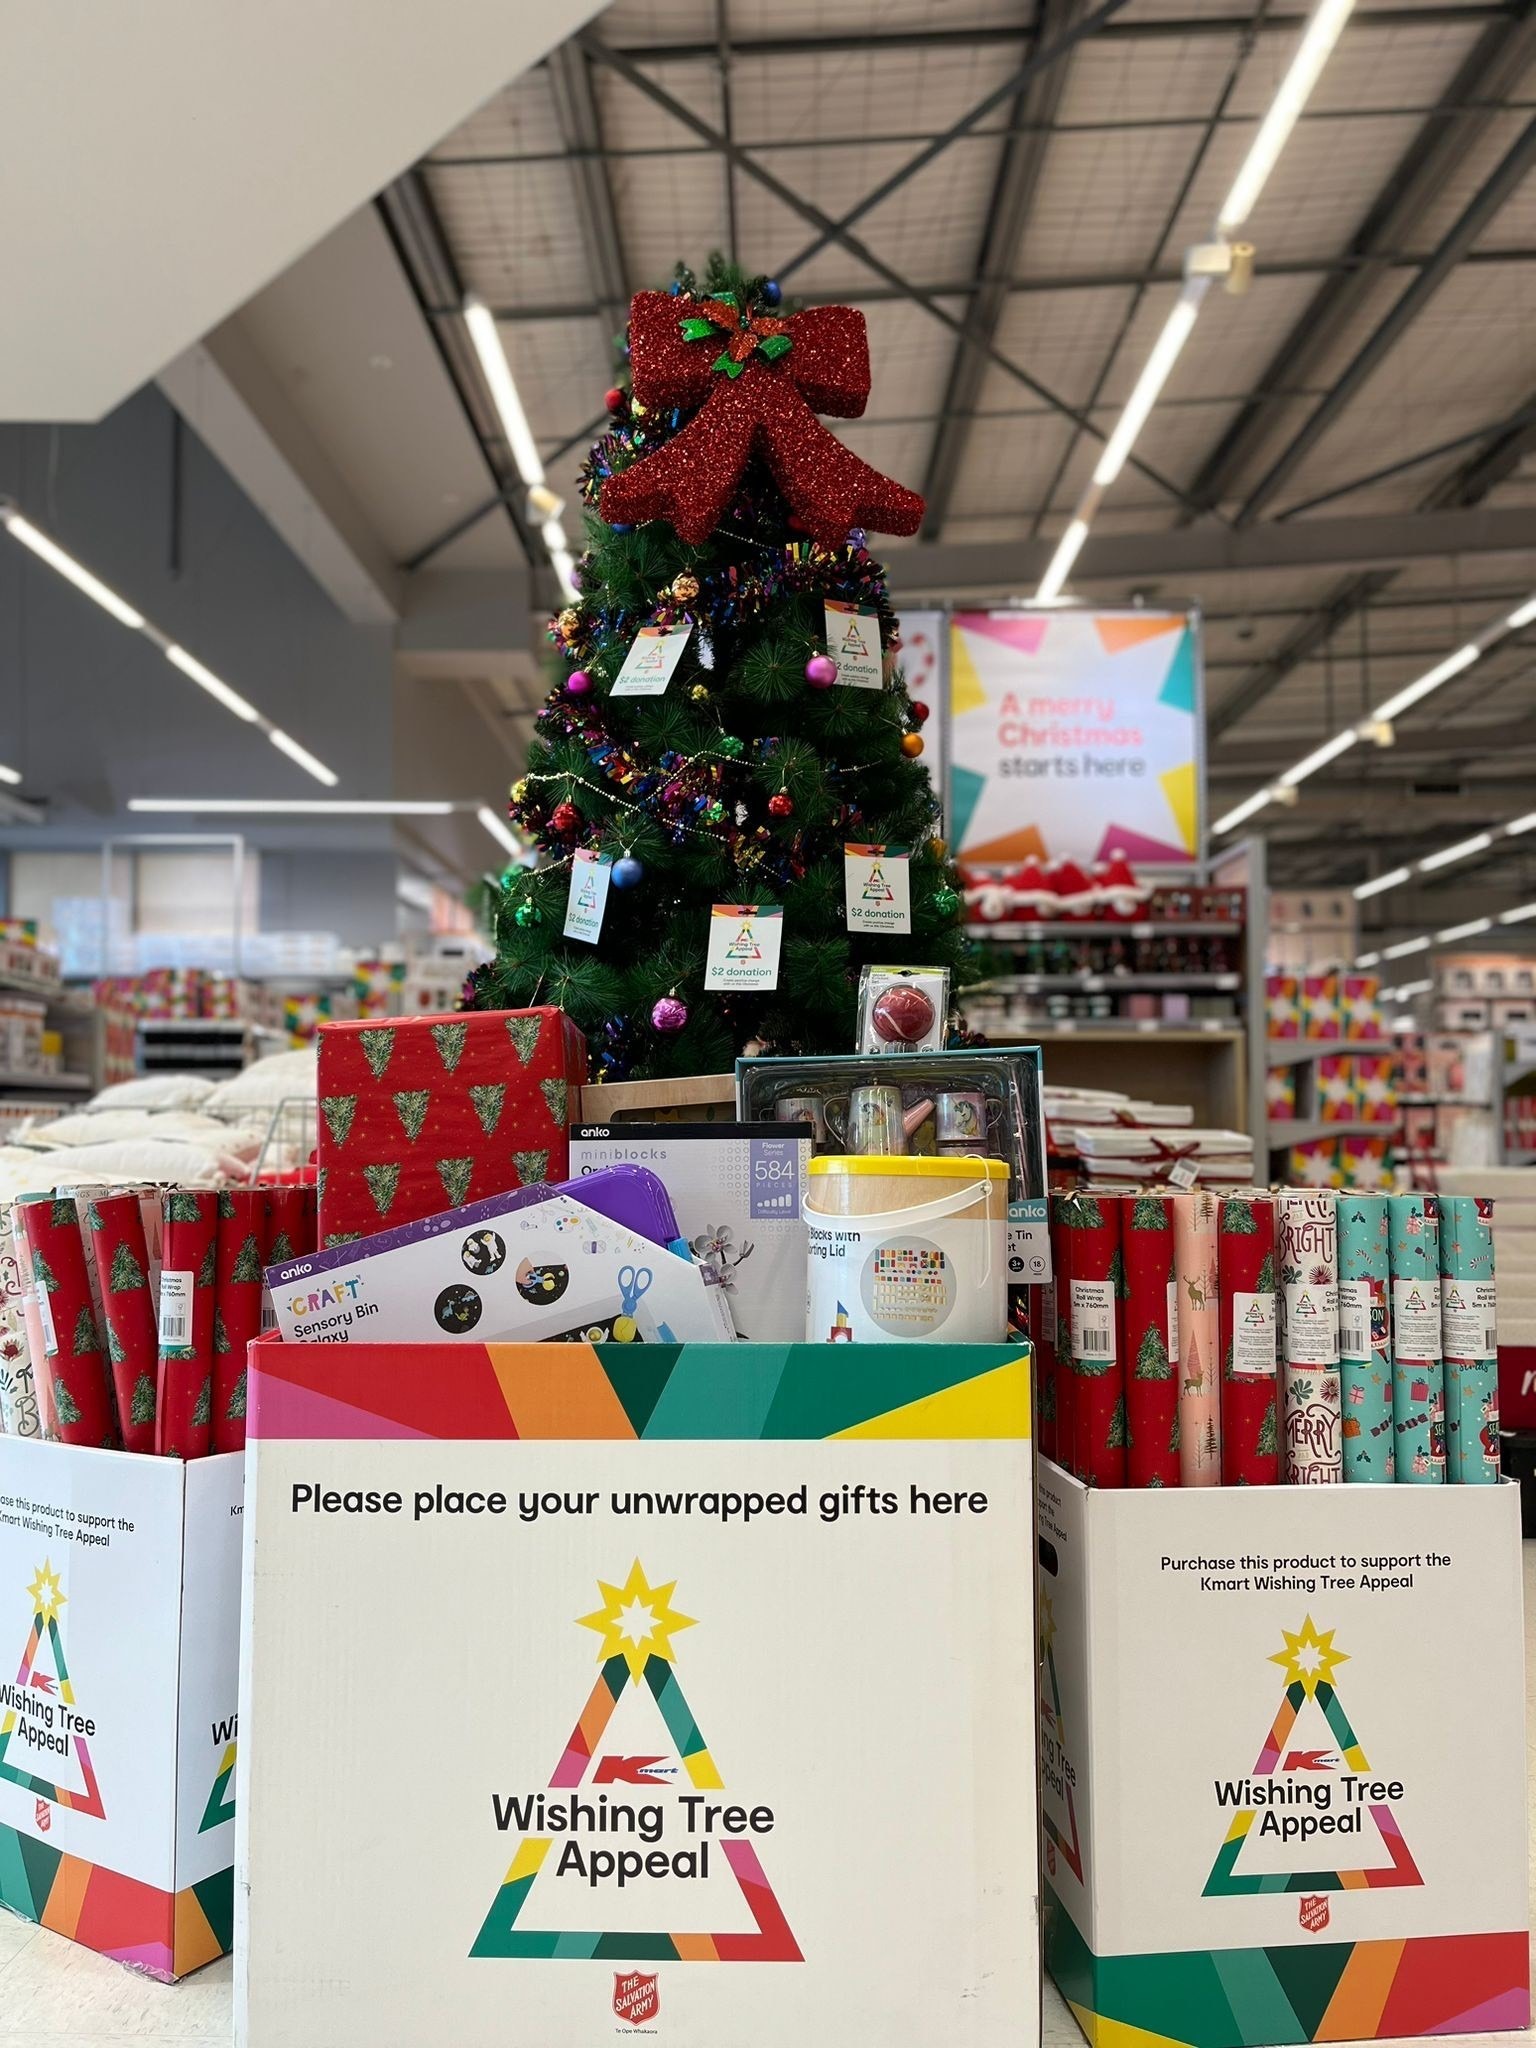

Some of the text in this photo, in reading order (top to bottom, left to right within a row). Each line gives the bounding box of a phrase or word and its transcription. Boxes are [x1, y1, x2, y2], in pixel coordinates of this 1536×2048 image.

[843, 663, 878, 674] donation
[1001, 693, 1114, 721] A merry
[998, 723, 1143, 748] Christmas
[1000, 755, 1145, 778] starts here
[568, 913, 599, 928] $2 donation
[851, 907, 905, 919] $2 donation
[711, 966, 772, 976] $2 donation
[580, 1126, 610, 1137] anko
[581, 1148, 667, 1160] miniblocks
[755, 1160, 795, 1180] 584
[1008, 1204, 1047, 1218] anko
[1015, 1229, 1033, 1240] Tin
[829, 1244, 846, 1257] Lid
[280, 1263, 313, 1280] anko
[1033, 1260, 1042, 1268] 18
[292, 1278, 359, 1316] CRAFT
[1075, 1286, 1105, 1294] Christmas
[294, 1303, 379, 1338] Sensory Bin
[299, 1330, 349, 1343] laxy
[0, 1495, 135, 1532] ase this product to support the
[230, 1504, 245, 1517] Km
[293, 1484, 988, 1522] Please place your unwrapped gifts here
[22, 1515, 53, 1538] Wishing
[54, 1524, 74, 1540] Tree
[75, 1529, 110, 1547] Appeal
[1161, 1552, 1452, 1573] Purchase this product to support the
[1200, 1574, 1414, 1593] Kmart Wishing Tree Appeal
[0, 1684, 96, 1737] Wishing Tree
[17, 1716, 69, 1757] Appeal
[211, 1713, 238, 1746] Wi
[592, 1756, 679, 1785] Kmart
[1056, 1740, 1076, 1787] Tree
[1282, 1749, 1341, 1772] Kmart
[1214, 1776, 1404, 1810] Wishing Tree
[492, 1793, 775, 1843] Wishing Tree
[1259, 1807, 1362, 1842] Appeal
[556, 1839, 708, 1888] Appeal
[1300, 1899, 1328, 1925] SALVATION
[1304, 1897, 1317, 1911] THE
[1310, 1910, 1327, 1930] ARMY
[615, 1978, 655, 2012] SALVATION
[621, 1975, 639, 1994] THE
[630, 1994, 654, 2019] ARMY
